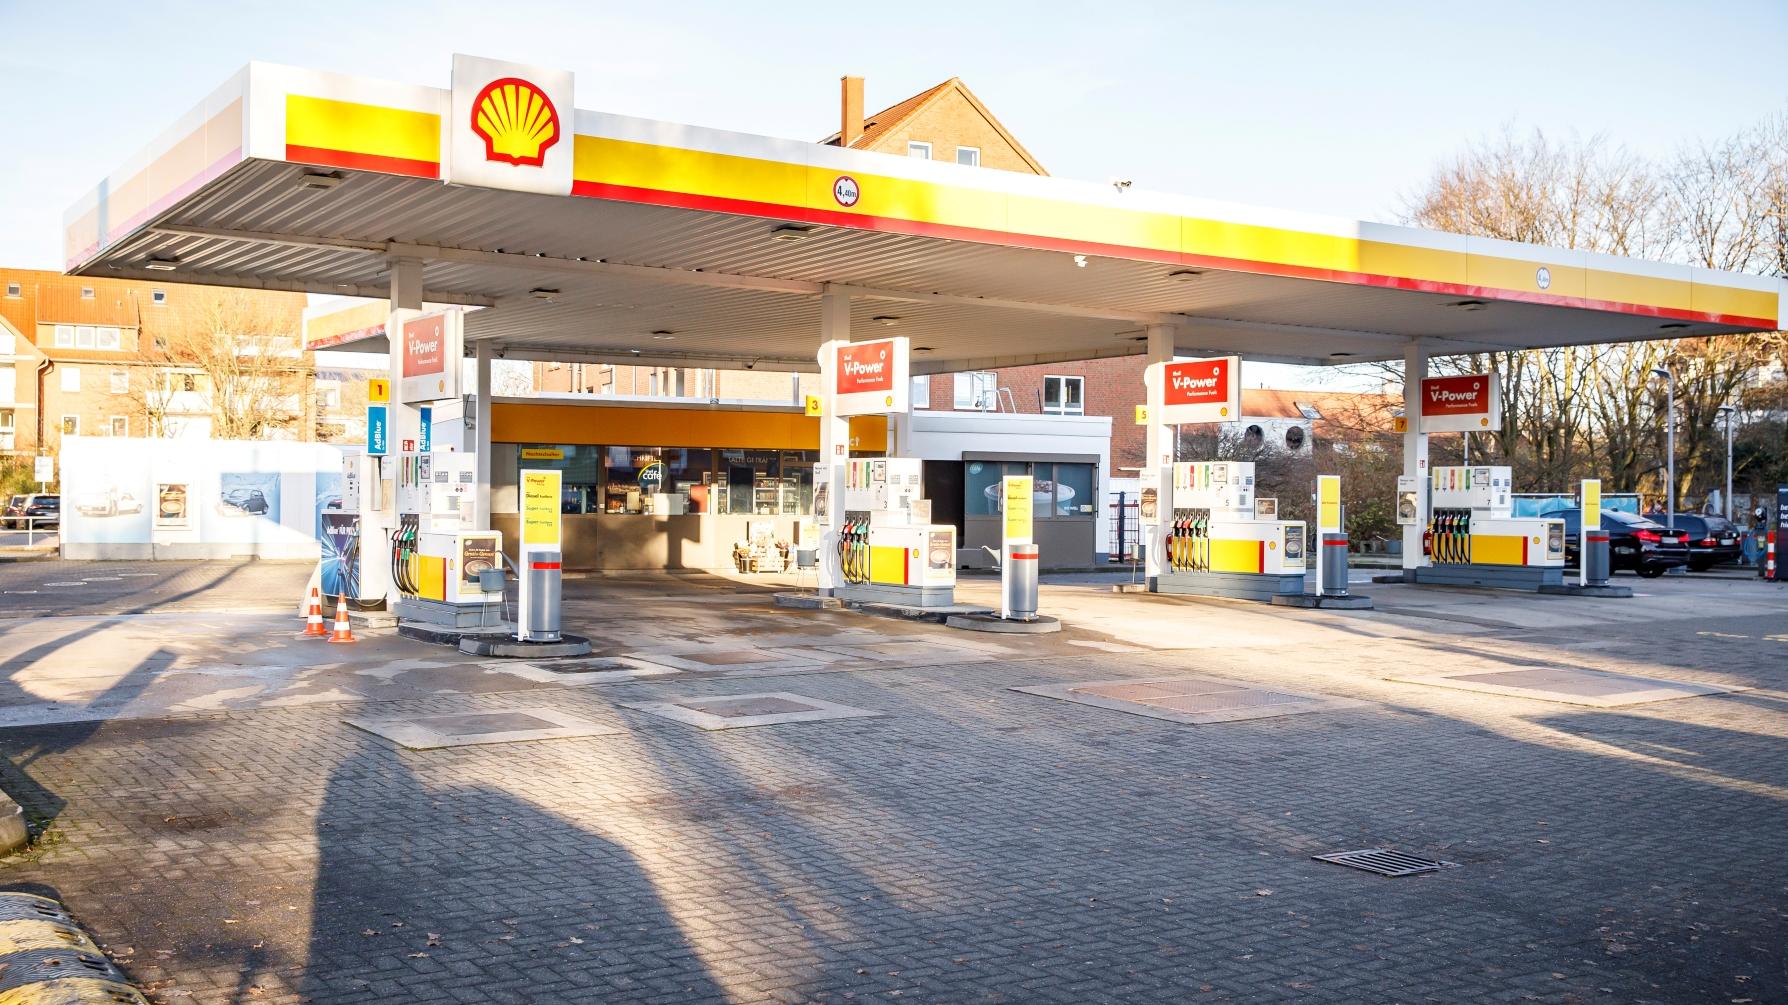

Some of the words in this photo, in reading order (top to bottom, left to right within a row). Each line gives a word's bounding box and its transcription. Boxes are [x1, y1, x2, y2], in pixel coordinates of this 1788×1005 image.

[408, 339, 438, 356] V-Power
[843, 361, 884, 376] V-Power
[1172, 376, 1218, 390] V-Power
[377, 384, 383, 396] 1
[1430, 390, 1478, 402] V-Power
[811, 400, 819, 411] 3
[1141, 410, 1147, 420] 5
[1400, 420, 1405, 429] 7
[374, 420, 382, 451] AdBlue
